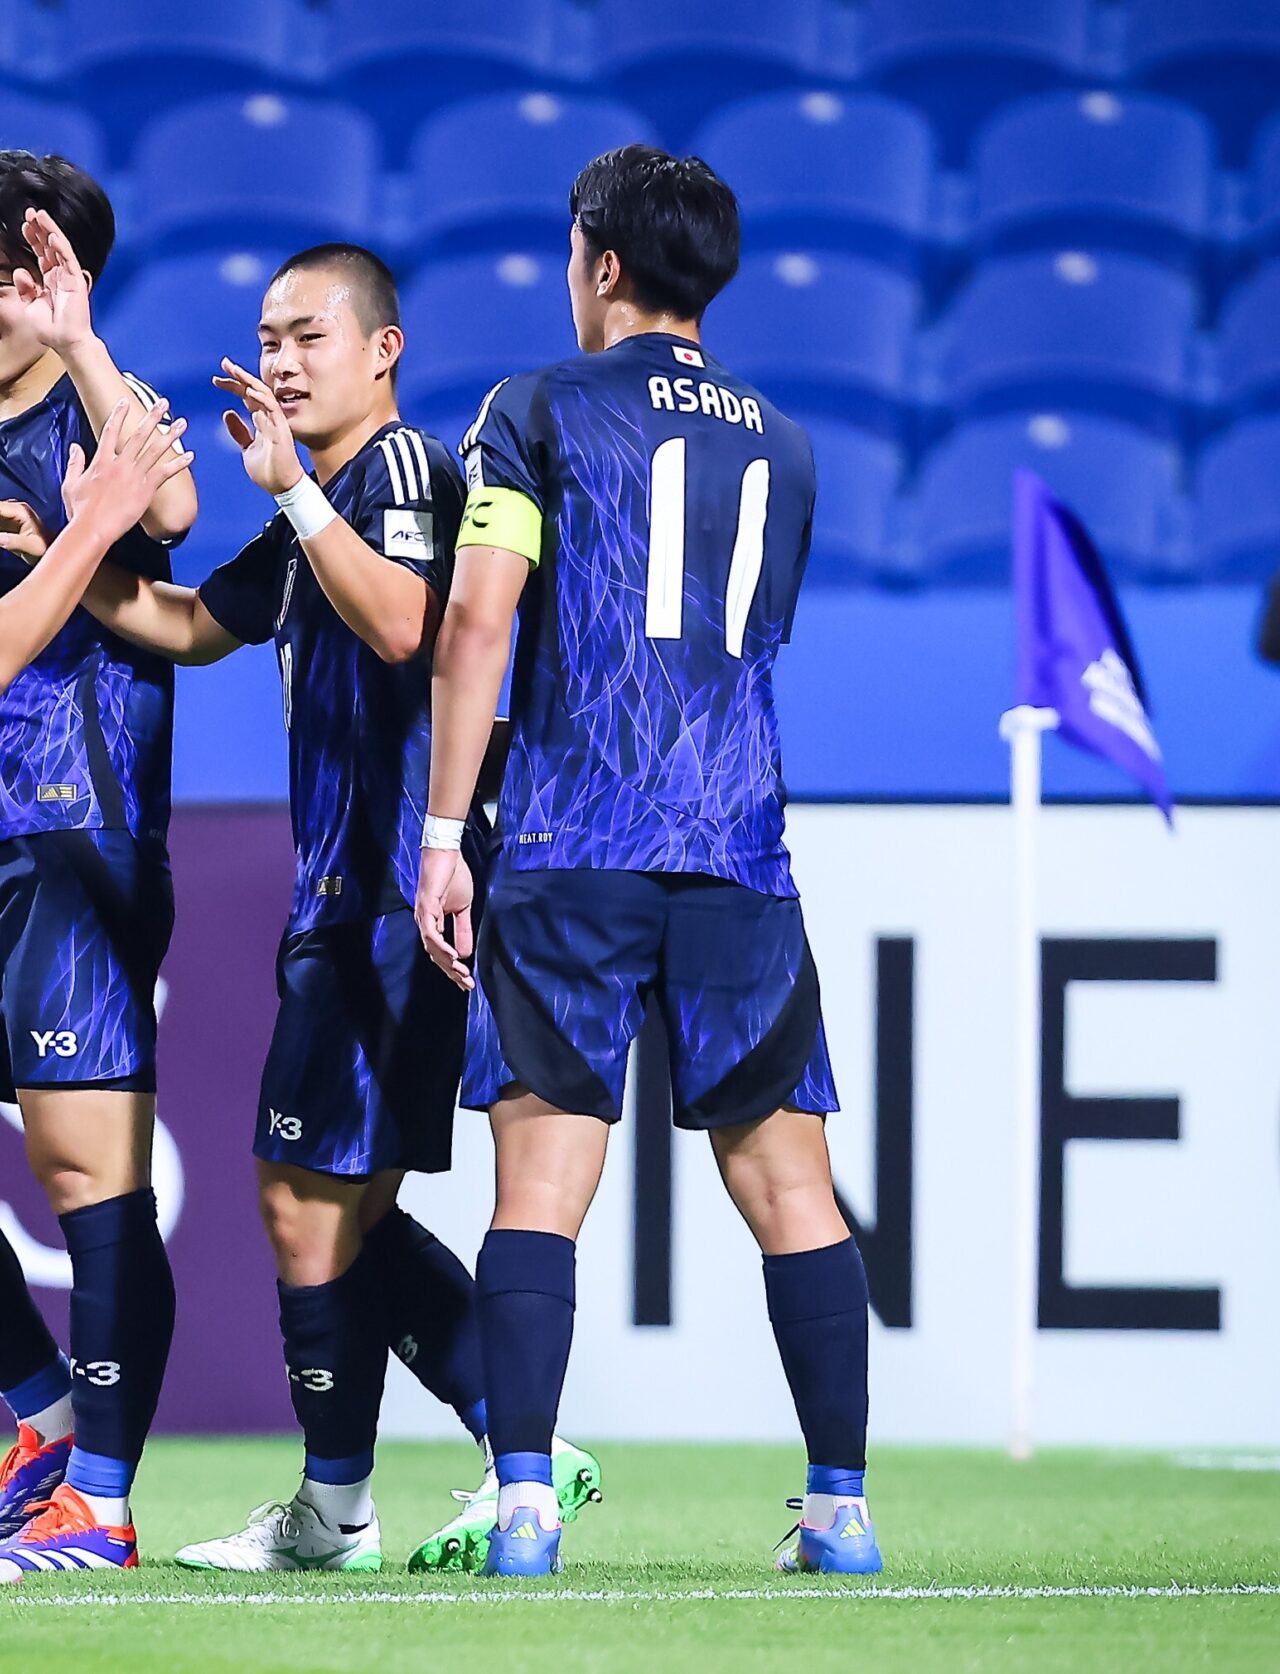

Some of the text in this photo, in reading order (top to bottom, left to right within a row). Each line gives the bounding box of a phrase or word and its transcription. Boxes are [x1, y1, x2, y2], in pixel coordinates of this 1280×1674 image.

[648, 376, 765, 435] ASADA
[391, 530, 428, 541] AFC
[645, 437, 770, 659] 11
[29, 1030, 78, 1057] Y-3
[269, 1108, 302, 1140] Y-3
